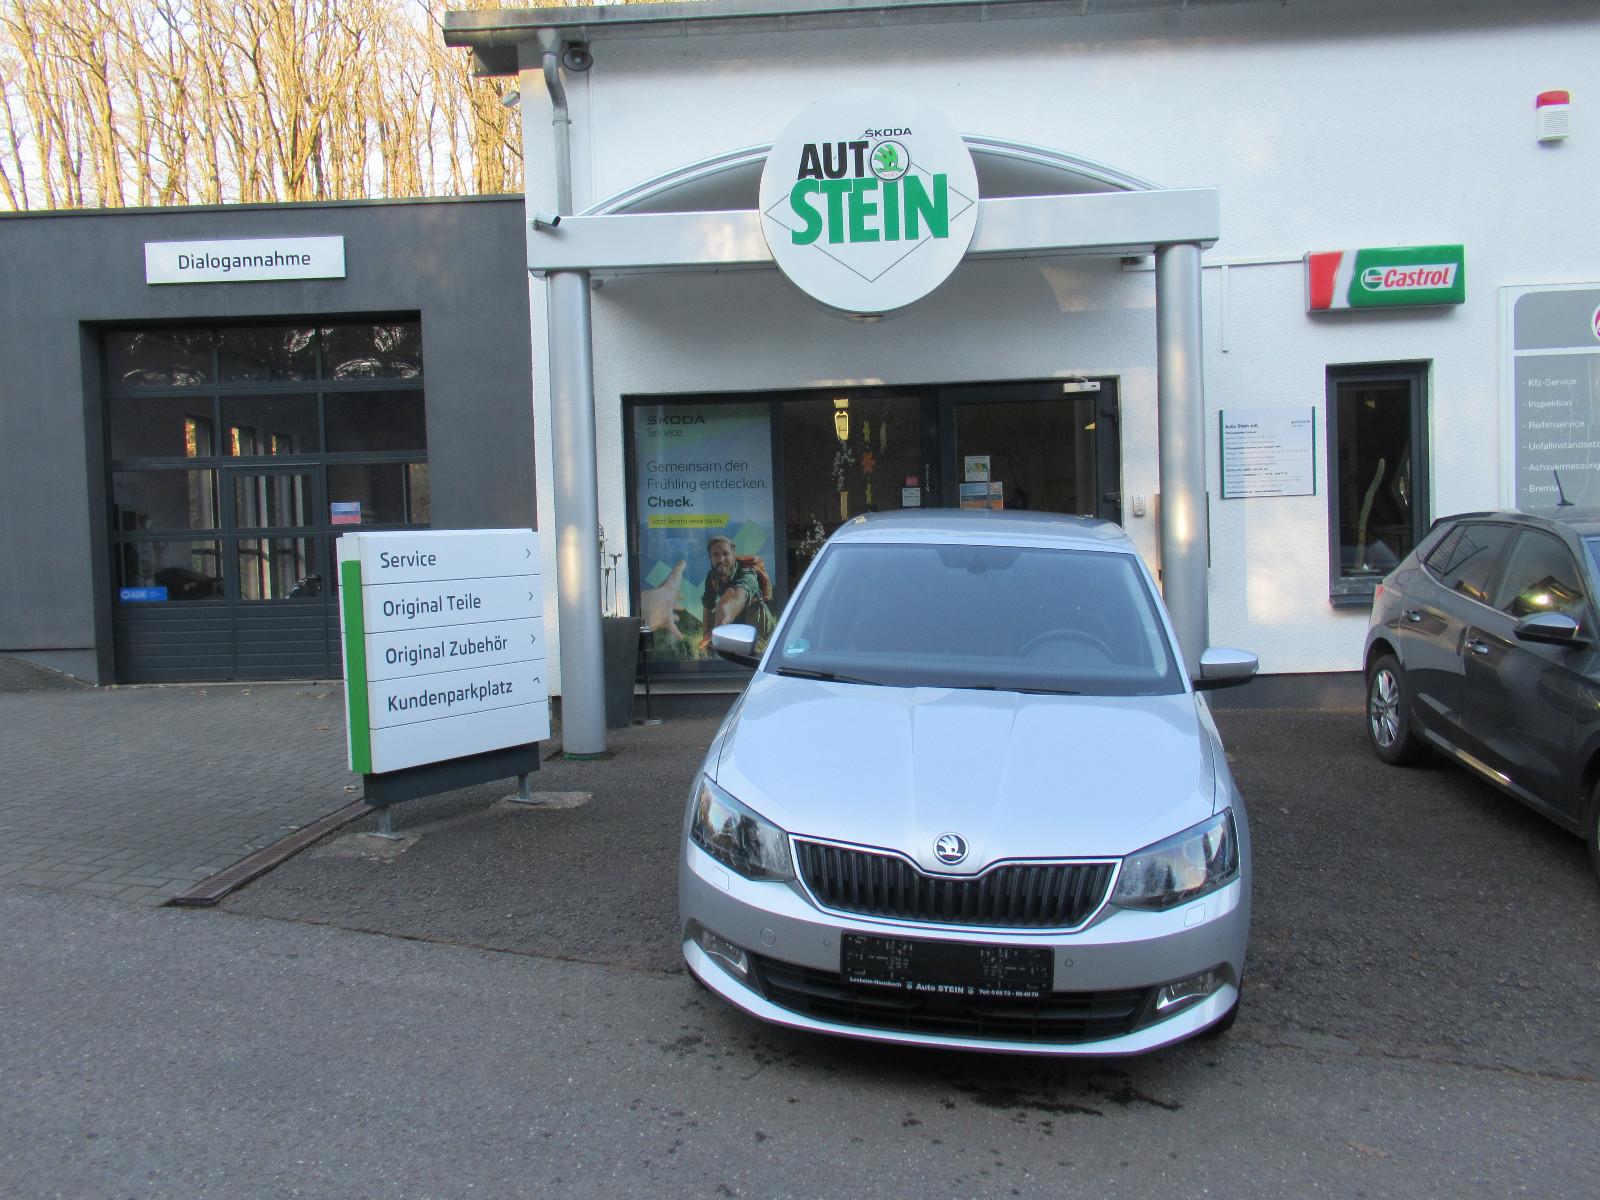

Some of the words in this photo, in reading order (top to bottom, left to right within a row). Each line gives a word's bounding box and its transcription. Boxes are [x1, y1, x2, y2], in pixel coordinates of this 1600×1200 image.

[790, 173, 949, 245] STEIN
[178, 251, 311, 272] Dialogannahme
[1384, 267, 1450, 287] Castrol
[1528, 400, 1572, 408] Inspektion
[646, 460, 722, 473] Gemeinsam
[725, 460, 748, 472] den
[647, 478, 697, 493] Frühling
[700, 477, 768, 490] entdecken.
[647, 496, 694, 508] Check.
[380, 550, 437, 569] Service
[383, 595, 443, 619] Original
[447, 593, 481, 611] Teile
[386, 641, 445, 665] Original
[449, 635, 508, 657] Zubehör
[388, 680, 513, 712] Kundenparkplatz
[915, 982, 936, 992] Auto
[938, 984, 964, 994] STEIN
